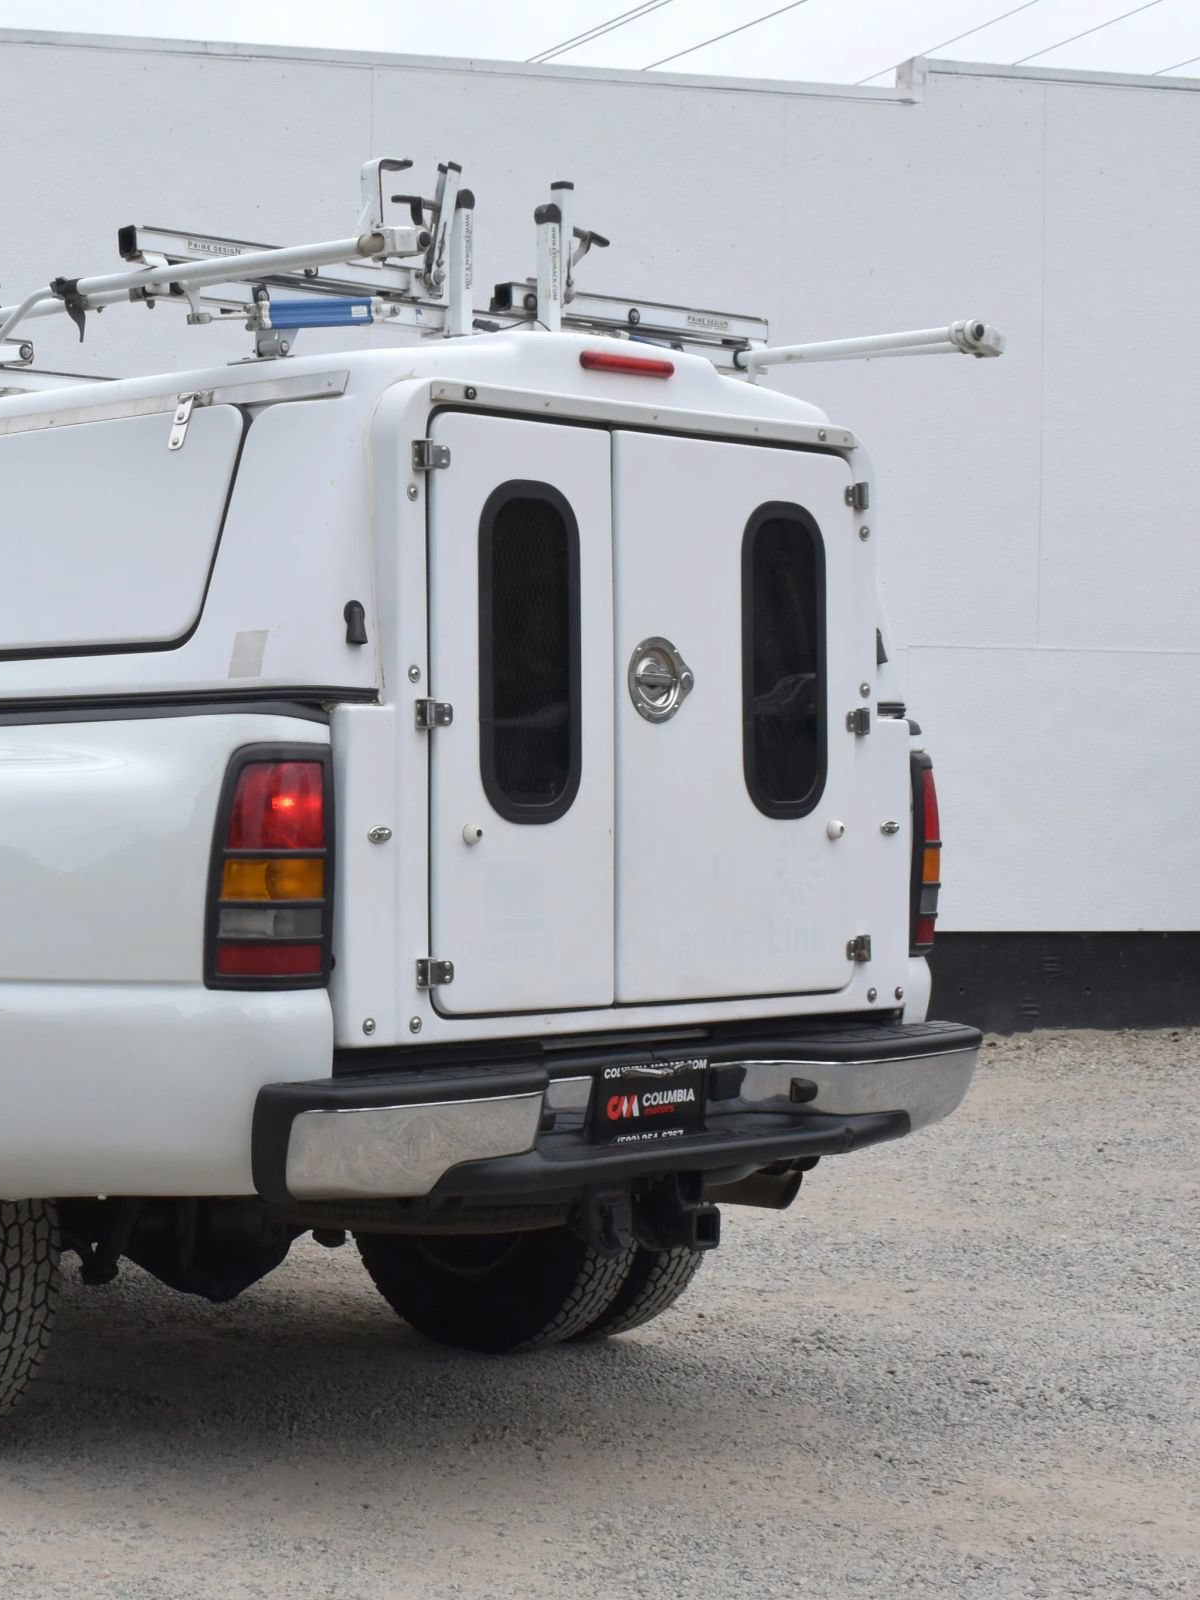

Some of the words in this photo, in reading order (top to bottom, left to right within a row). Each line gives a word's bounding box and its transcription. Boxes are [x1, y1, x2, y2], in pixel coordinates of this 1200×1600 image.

[187, 240, 210, 251] PRIME
[213, 245, 241, 255] DESIGN
[642, 1088, 696, 1107] COLUMBIA
